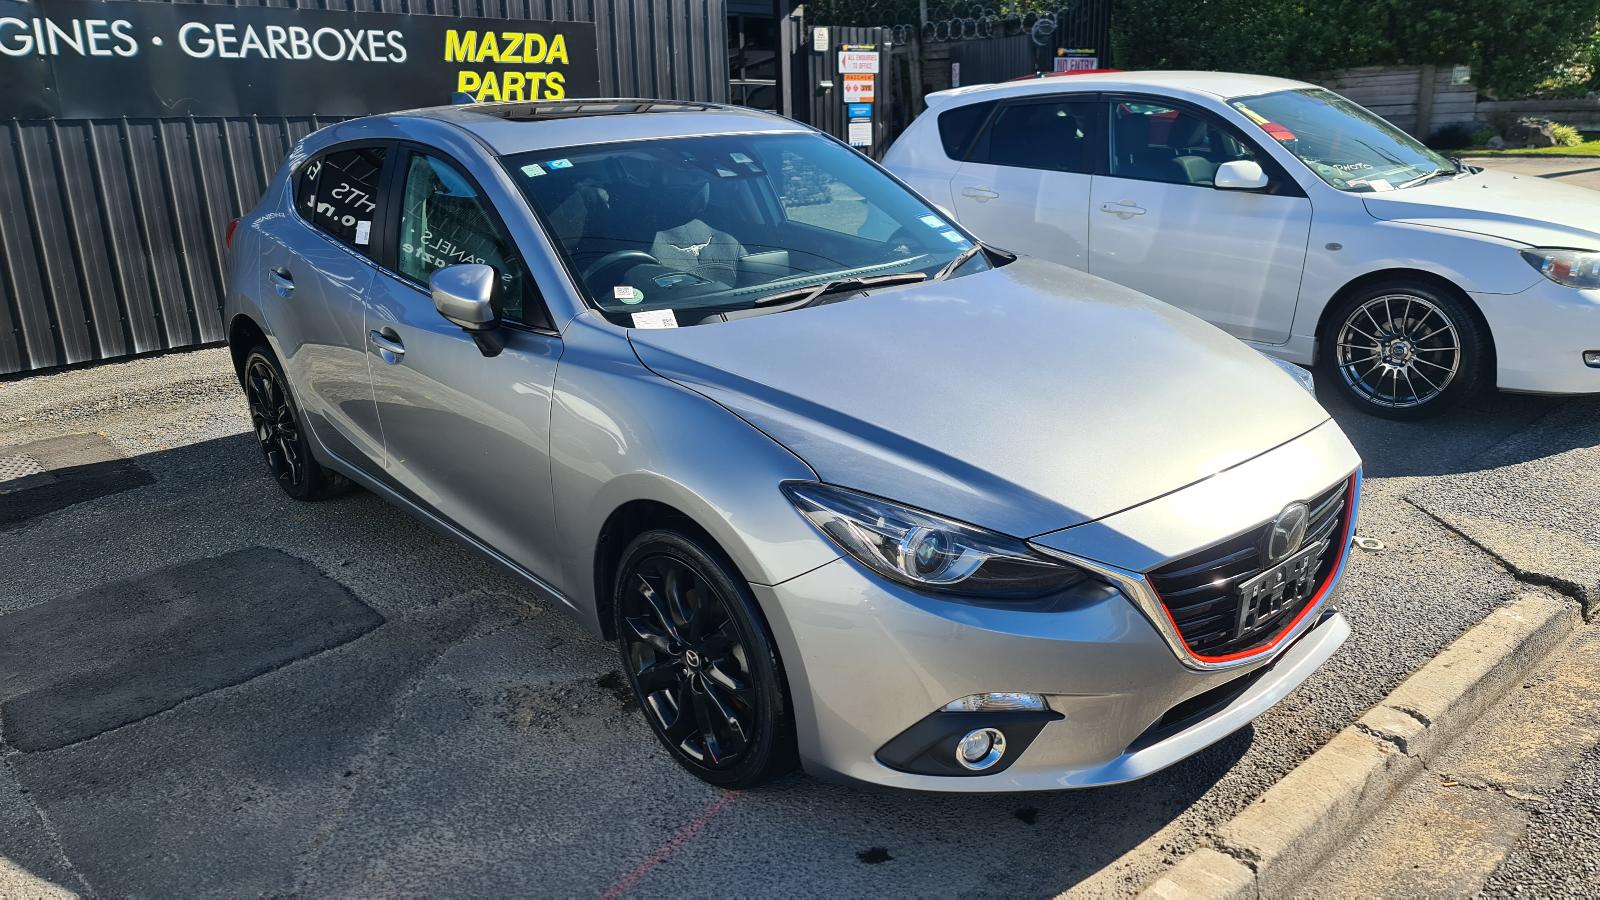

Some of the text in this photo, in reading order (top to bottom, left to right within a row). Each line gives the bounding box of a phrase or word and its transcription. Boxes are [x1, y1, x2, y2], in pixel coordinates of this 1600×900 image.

[178, 22, 407, 64] GEARBOXES
[444, 29, 569, 65] MAZDA
[1070, 58, 1095, 71] ENTRY
[457, 70, 566, 102] PARTS
[1333, 163, 1374, 175] PHOTO
